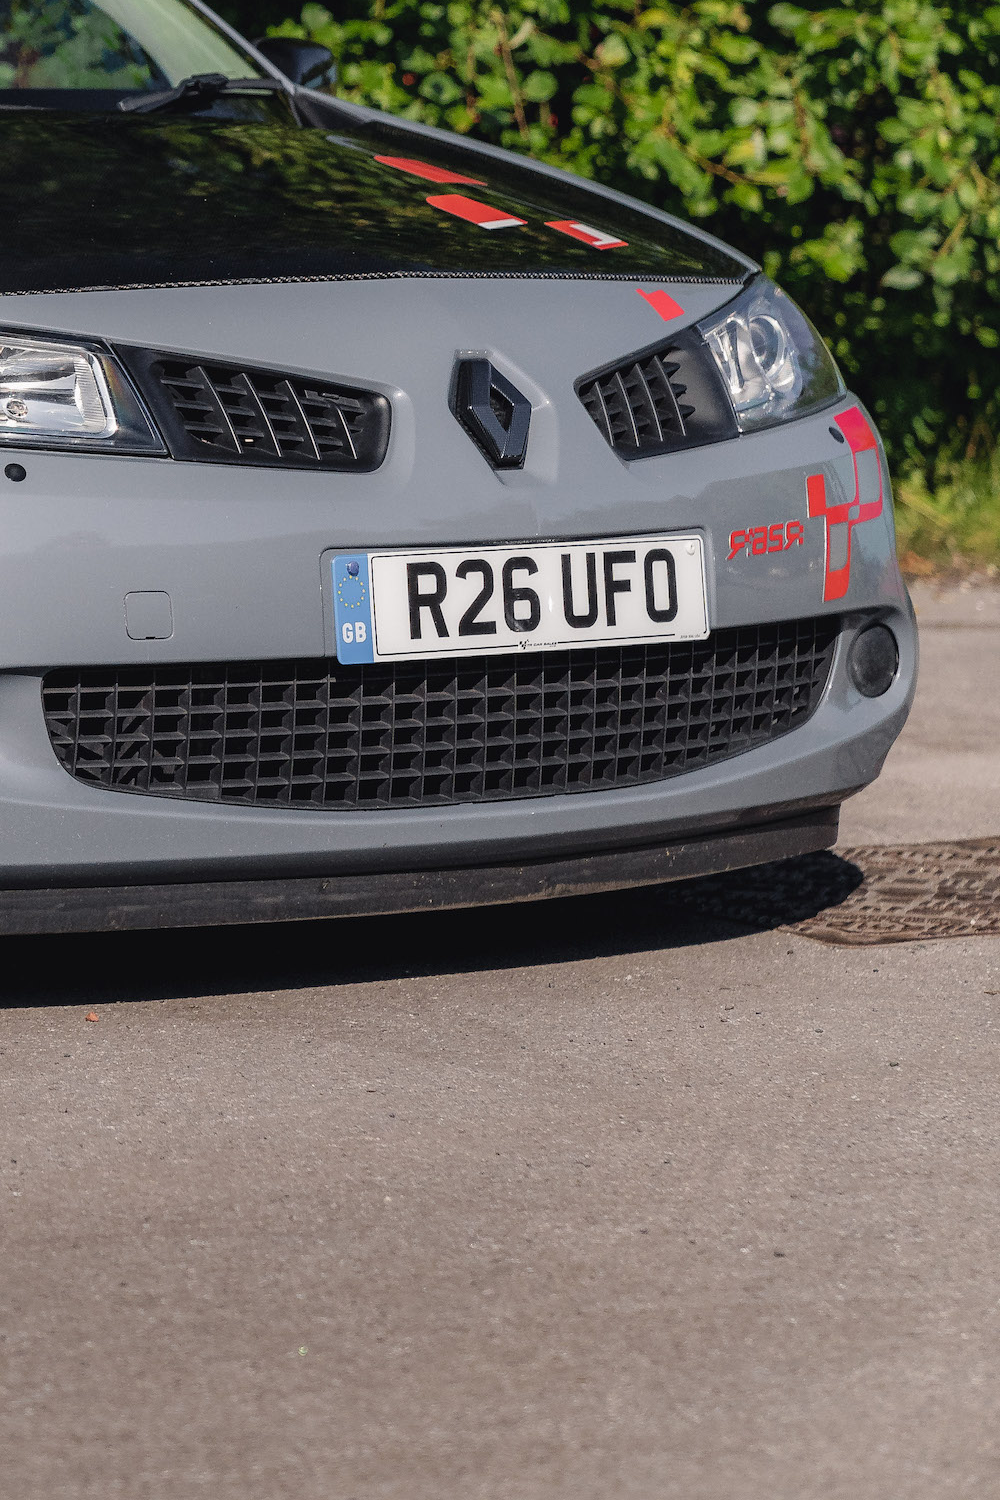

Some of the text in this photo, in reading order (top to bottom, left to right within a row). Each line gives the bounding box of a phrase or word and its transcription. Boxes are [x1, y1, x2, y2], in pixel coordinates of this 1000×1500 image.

[406, 548, 678, 639] R26 UFO
[342, 622, 367, 644] GB
